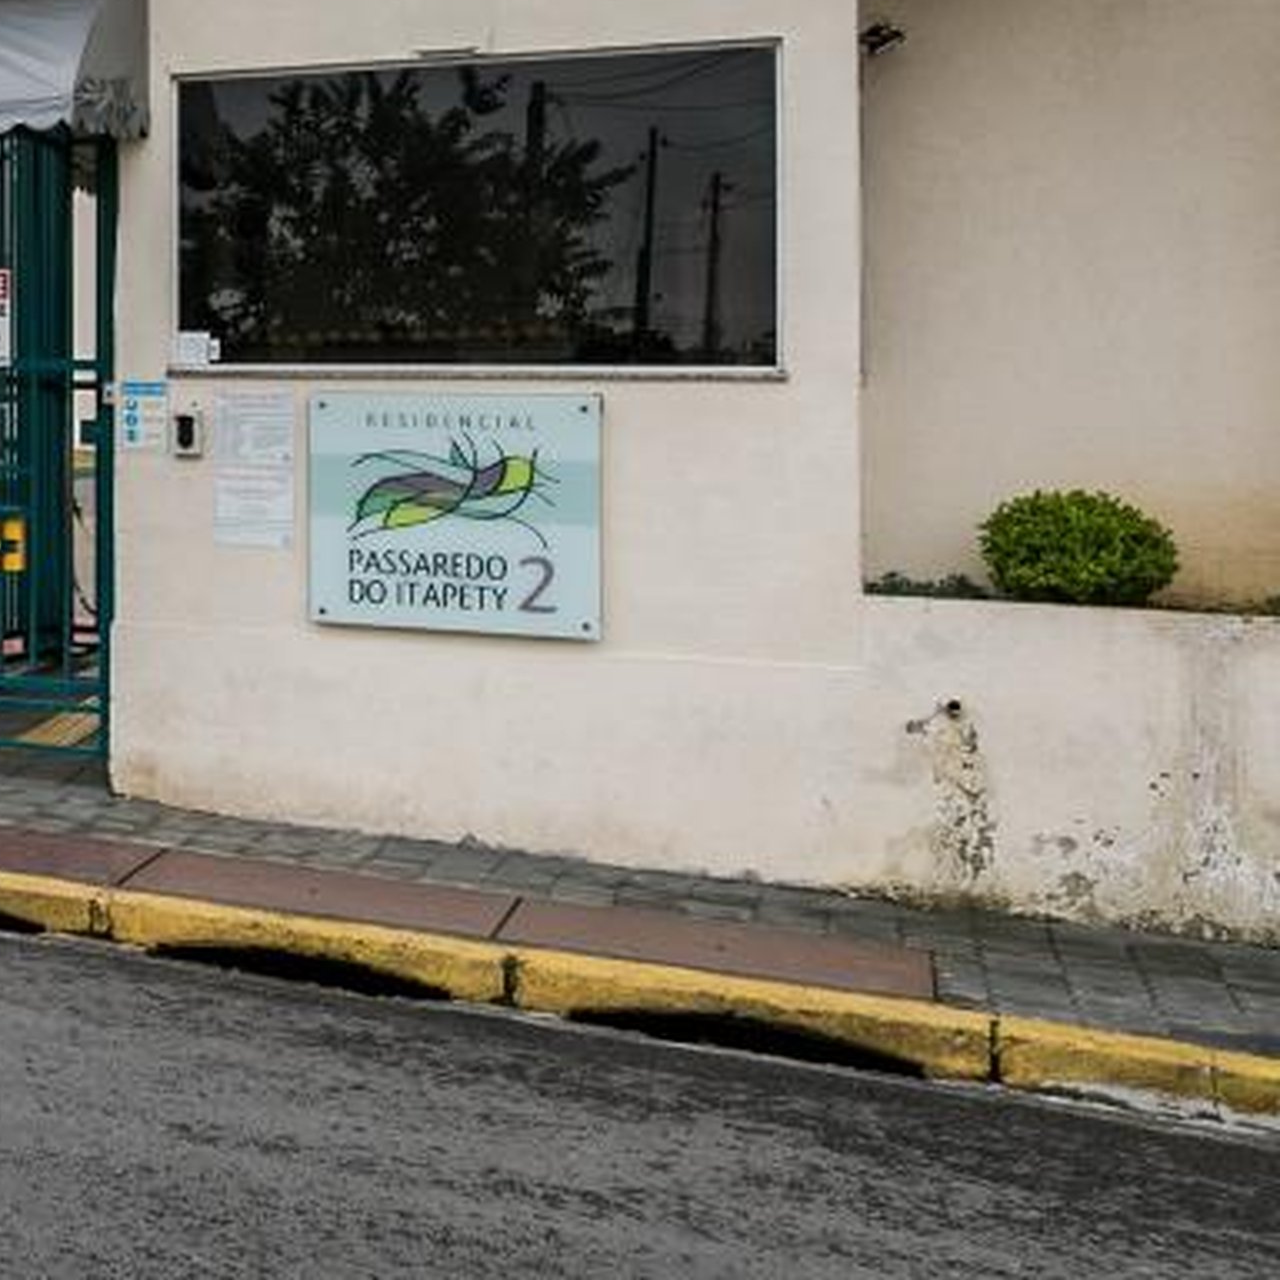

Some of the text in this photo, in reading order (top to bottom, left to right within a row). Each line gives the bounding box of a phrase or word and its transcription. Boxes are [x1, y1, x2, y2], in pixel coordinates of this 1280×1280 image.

[364, 411, 537, 430] RESIDENCIAL
[348, 548, 509, 581] PASSAREDO
[348, 579, 509, 611] DO ITAPETY
[516, 555, 559, 614] 2
